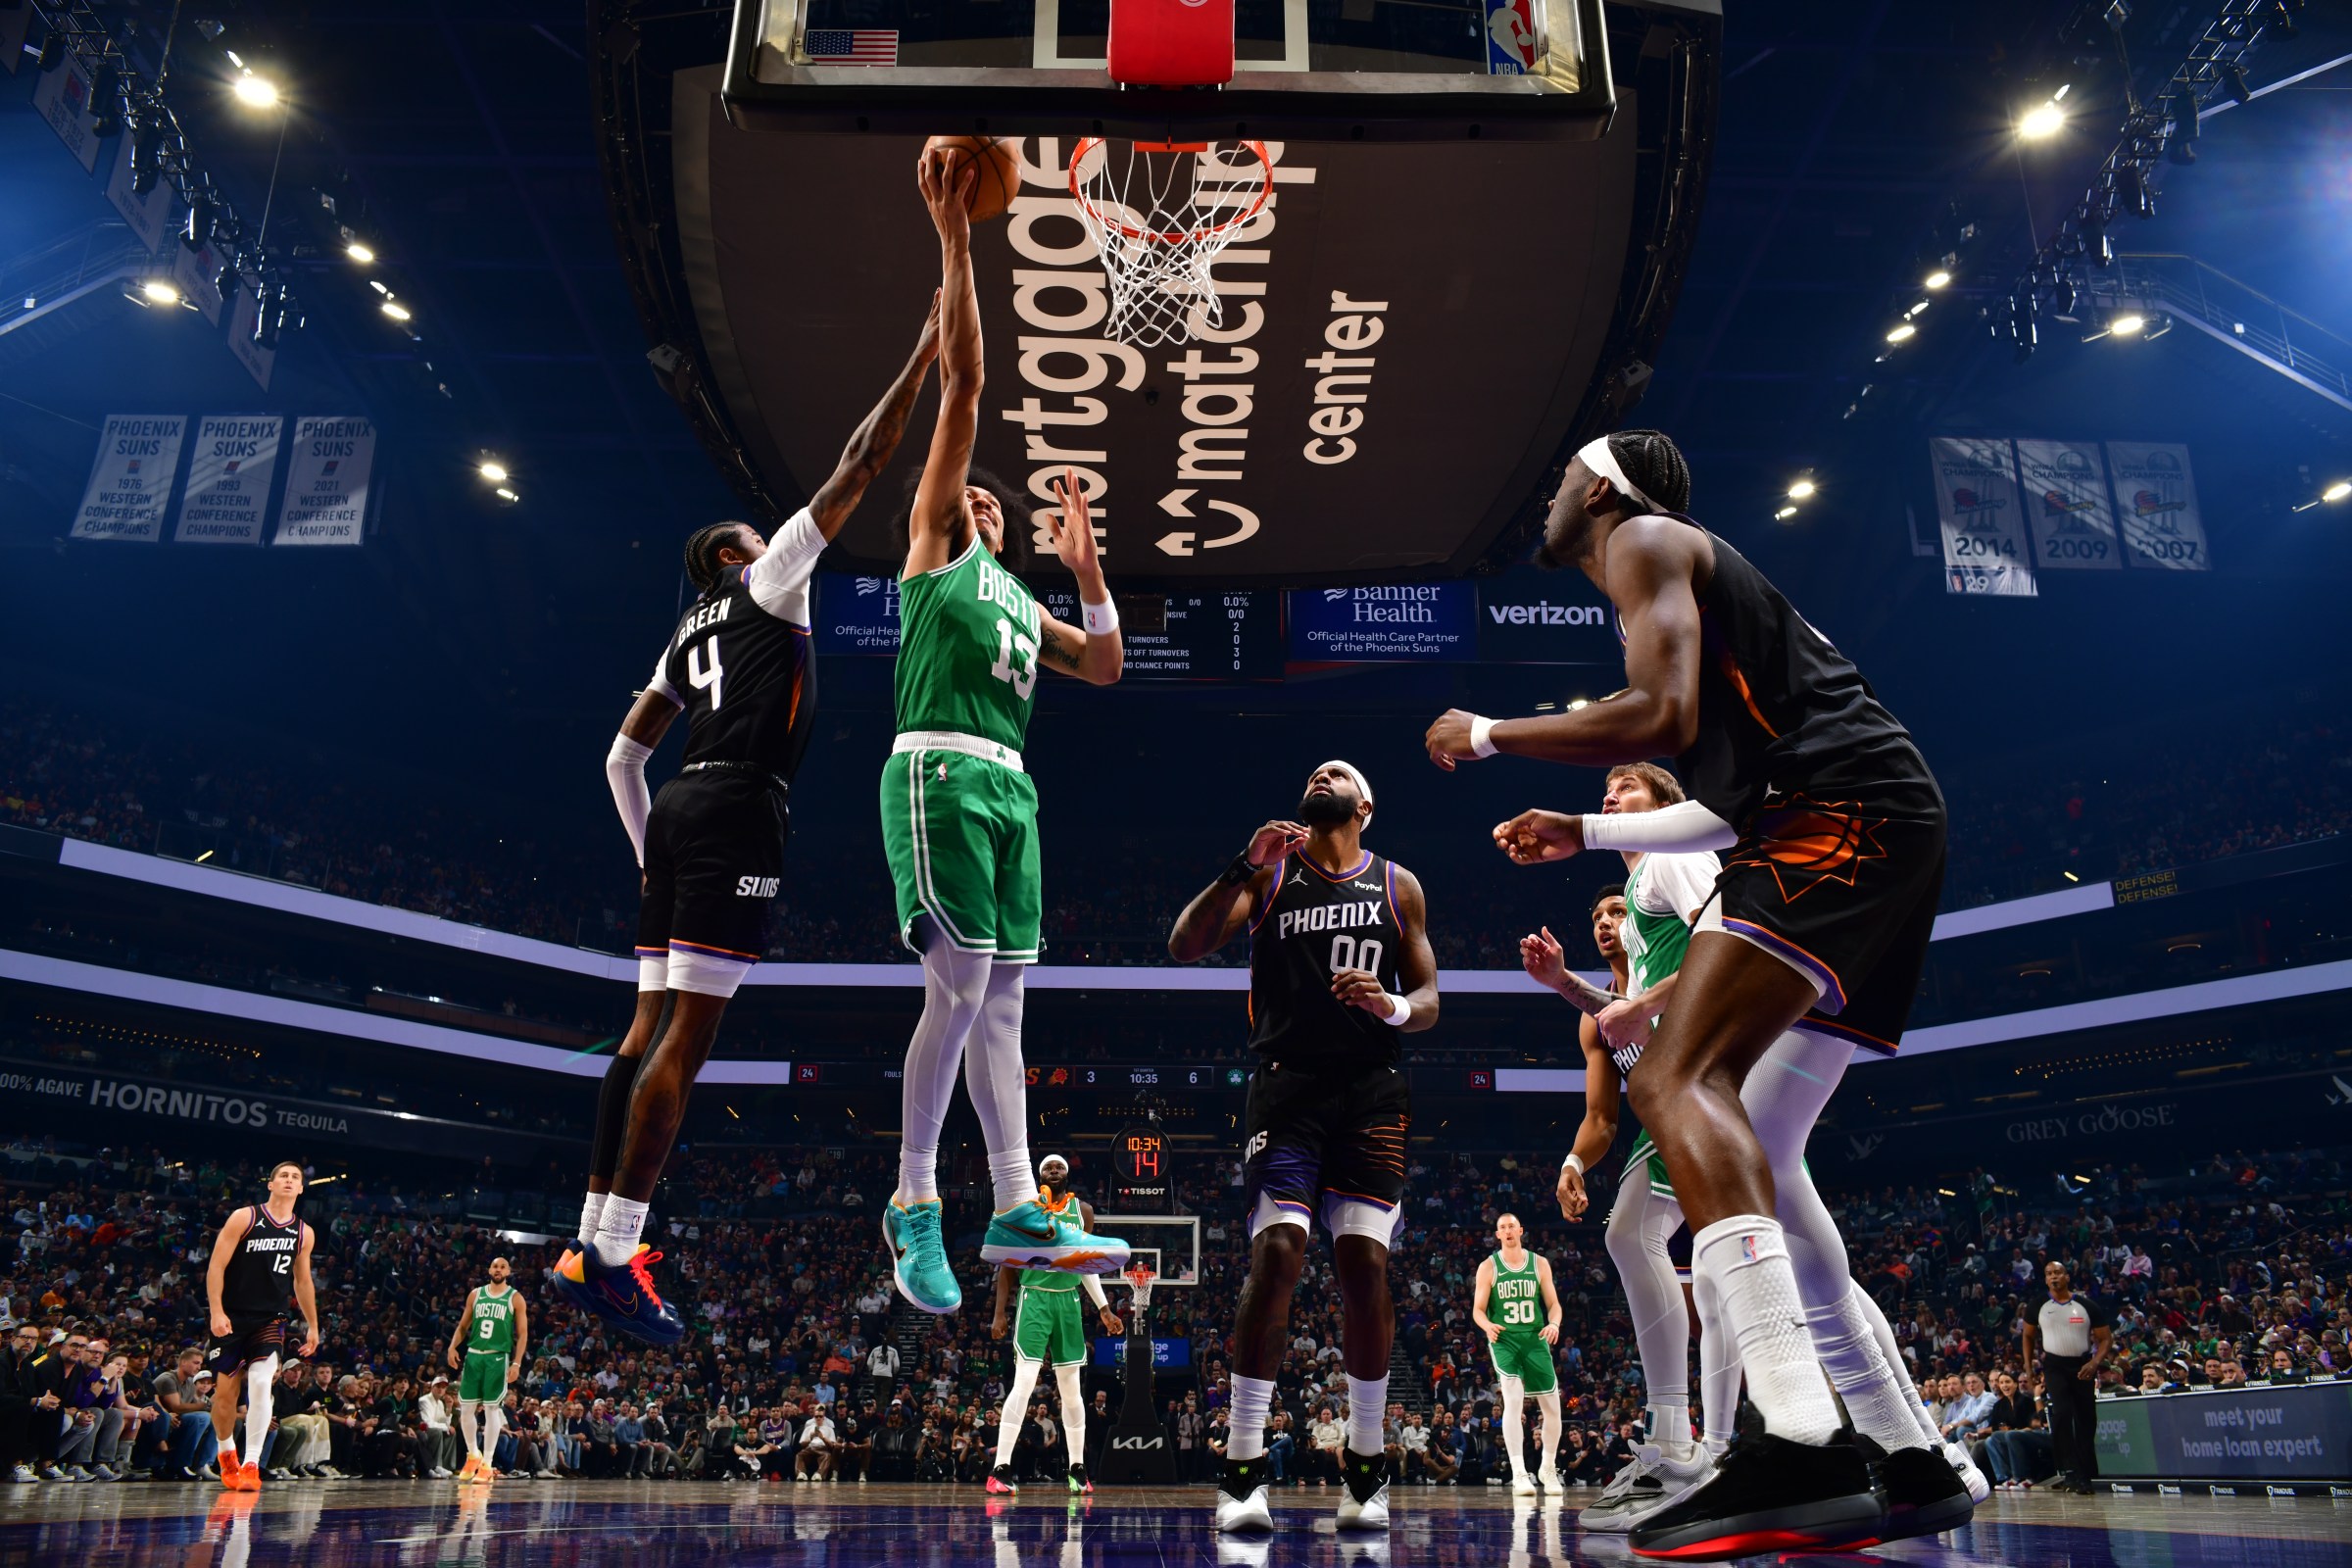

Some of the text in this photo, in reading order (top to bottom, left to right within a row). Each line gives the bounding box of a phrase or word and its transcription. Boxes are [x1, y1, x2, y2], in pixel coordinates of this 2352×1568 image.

[1495, 63, 1519, 75] NBA
[1158, 141, 1316, 480] matchup
[1002, 137, 1147, 556] mortgage
[1302, 289, 1389, 465] center
[108, 420, 180, 437] PHOENIX
[203, 422, 276, 438] PHOENIX
[302, 422, 371, 437] PHOENIX
[116, 439, 161, 456] SUNS
[213, 441, 257, 457] SUNS
[313, 441, 354, 457] SUNS
[1943, 468, 2005, 478] CHAMPIONS
[2033, 470, 2095, 480] CHAMPIONS
[2122, 470, 2183, 481] CHAMPIONS
[118, 478, 143, 489] 1976
[217, 480, 241, 491] 1993
[314, 480, 339, 491] 2021
[100, 492, 152, 505] WESTERN
[199, 494, 251, 507] WESTERN
[300, 495, 349, 507] WESTERN
[84, 506, 157, 520] CONFERENCE
[186, 510, 258, 521] CONFERENCE
[287, 510, 357, 521] CONFERENCE
[84, 520, 150, 535] CHAMPIONS
[186, 524, 251, 537] CHAMPIONS
[288, 525, 350, 536] CHAMPIONS
[1955, 537, 2016, 558] 2014
[2046, 540, 2108, 560] 2009
[2136, 540, 2197, 561] 2007
[977, 560, 1041, 641] BOSTO
[1049, 594, 1073, 605] 0.0%
[1352, 586, 1441, 601] Banner
[1224, 597, 1250, 607] 0.0%
[1053, 607, 1068, 617] 0/0
[1228, 610, 1245, 619] 0/0
[1352, 602, 1435, 622] Health
[1489, 600, 1604, 625] verizon
[677, 597, 732, 647] GREEN
[1233, 622, 1240, 632] 2
[835, 625, 901, 635] Official Hea
[1307, 630, 1459, 643] Official Health Care Partner
[857, 637, 869, 646] of
[871, 637, 890, 646] the
[1233, 635, 1240, 644] 0
[1233, 648, 1240, 658] 3
[1330, 643, 1440, 653] of the Phoenix Suns
[991, 618, 1038, 701] 13
[1233, 661, 1240, 670] 0
[688, 634, 723, 711] 4
[1354, 880, 1383, 892] PayPal
[2116, 870, 2175, 891] DEFENSE!
[2118, 884, 2178, 904] DEFENSE!
[1279, 901, 1383, 940] PHOENIX
[1329, 934, 1383, 977] 00
[802, 1068, 813, 1077] 24
[1087, 1071, 1096, 1083] 3
[1130, 1073, 1158, 1084] 10:35
[1189, 1072, 1198, 1084] 6
[1474, 1074, 1486, 1085] 24
[0, 1073, 83, 1097] 00% AGAVE
[90, 1079, 348, 1133] HORNITOS TEQUILA
[2007, 1104, 2174, 1144] GREY GOOSE
[1128, 1137, 1160, 1151] 10:34
[1137, 1152, 1158, 1176] 14
[246, 1238, 297, 1252] PHOENIX
[272, 1253, 292, 1274] 12
[1496, 1279, 1537, 1299] BOSTON
[475, 1302, 507, 1321] BOSTON
[1503, 1300, 1535, 1324] 30
[480, 1319, 494, 1339] 9
[2204, 1406, 2282, 1431] meet your
[2096, 1419, 2127, 1441] gage
[2181, 1435, 2323, 1462] home loan expert
